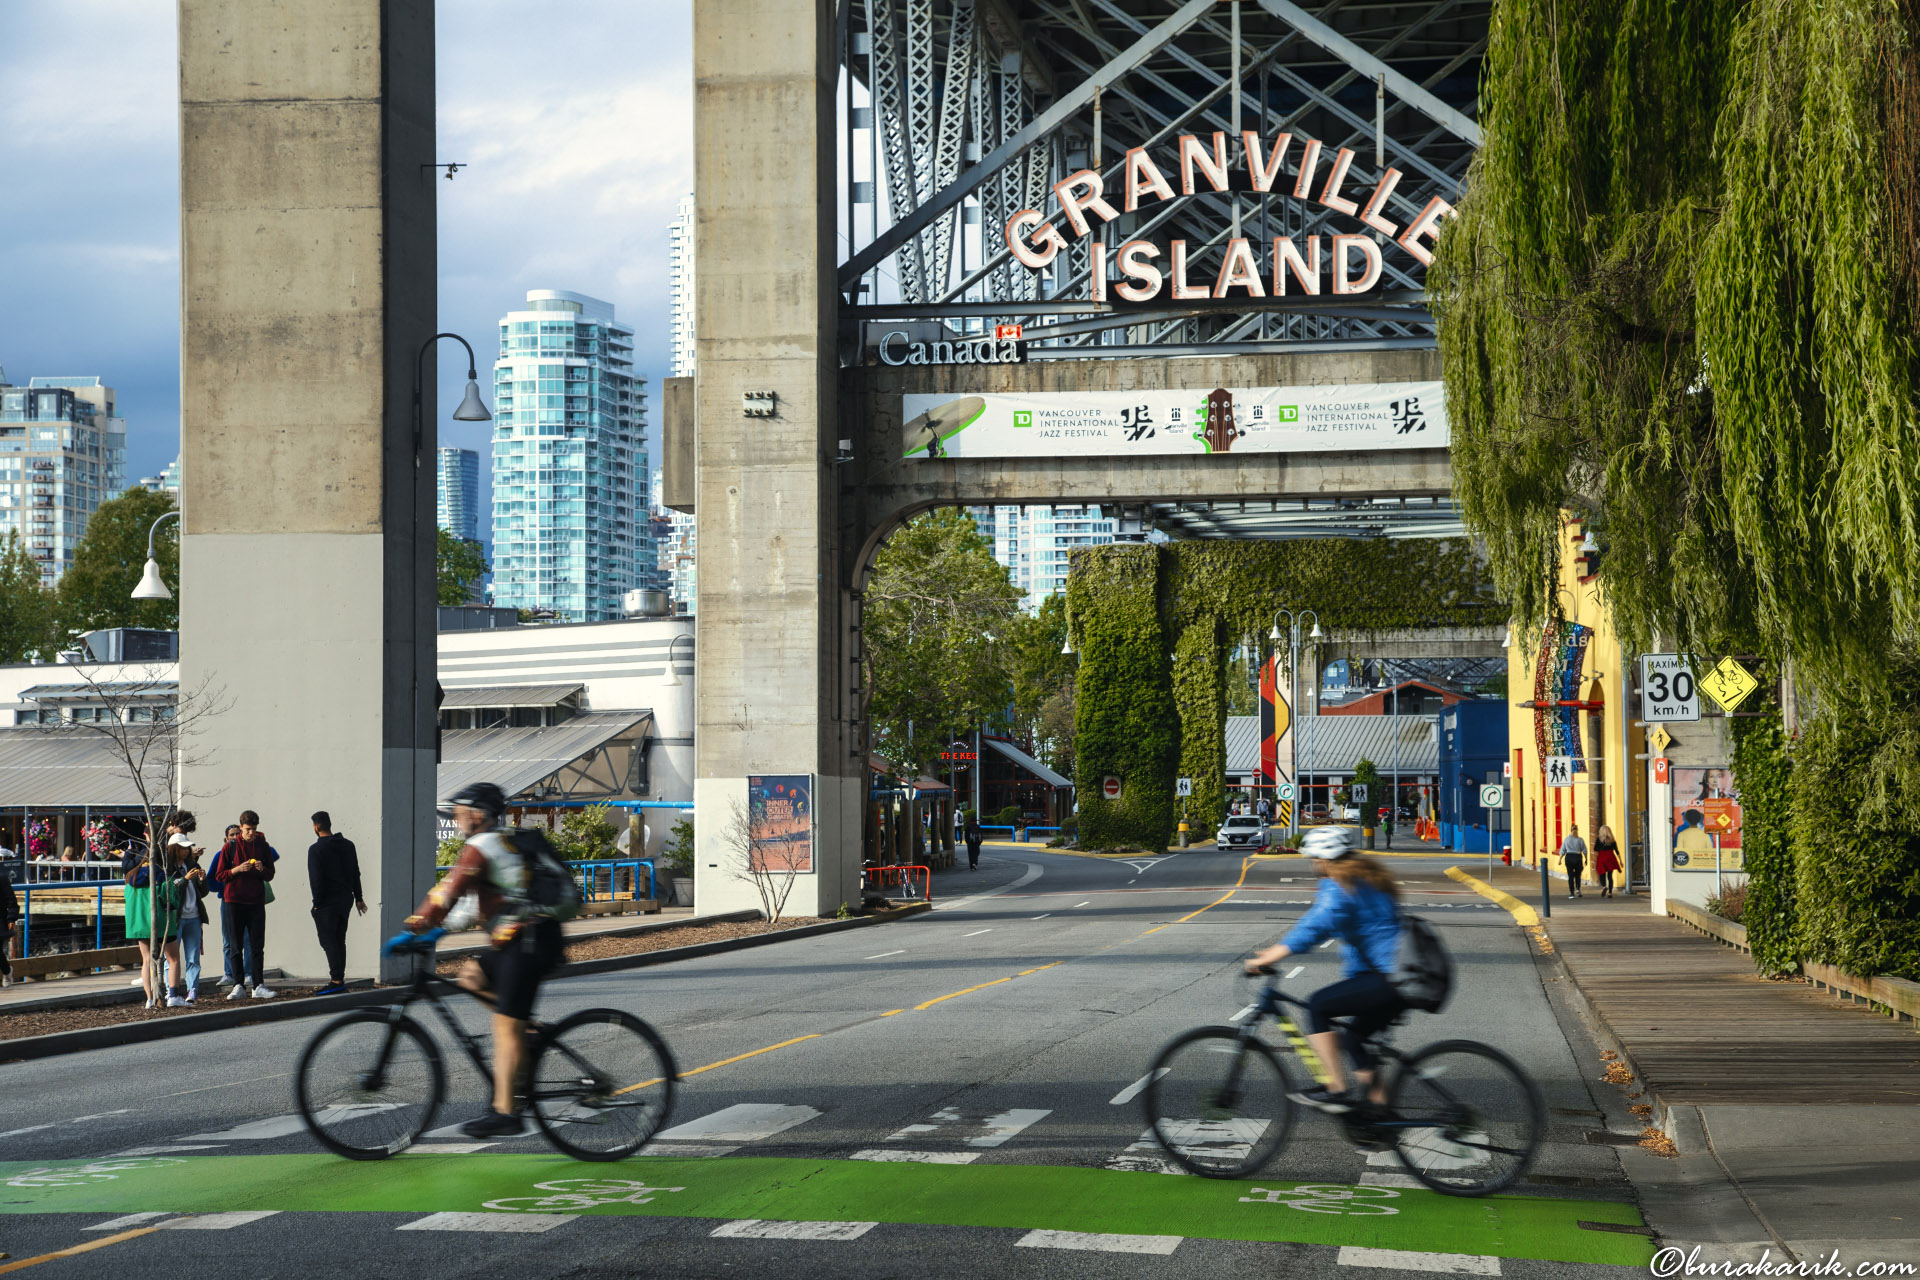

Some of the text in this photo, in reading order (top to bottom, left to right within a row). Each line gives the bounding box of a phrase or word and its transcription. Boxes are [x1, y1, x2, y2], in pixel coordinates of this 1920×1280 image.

[1005, 131, 1459, 268] GRANVILLE
[1091, 234, 1384, 301] ISLAND
[879, 329, 1022, 366] Canada
[1305, 402, 1370, 411] VANCOUVER
[1039, 409, 1102, 417] VANCOUVER
[1307, 412, 1388, 422] INTERNATIONAL
[1041, 419, 1119, 427] INTERNATIONAL
[1306, 423, 1377, 432] JAZZ FESTIVAL
[1039, 429, 1108, 438] JAZZ FESTIVAL
[1648, 671, 1694, 702] 30
[1550, 657, 1568, 756] MARKET
[1653, 705, 1689, 715] km/h
[940, 752, 977, 760] THE KEG
[766, 806, 793, 814] OUTER
